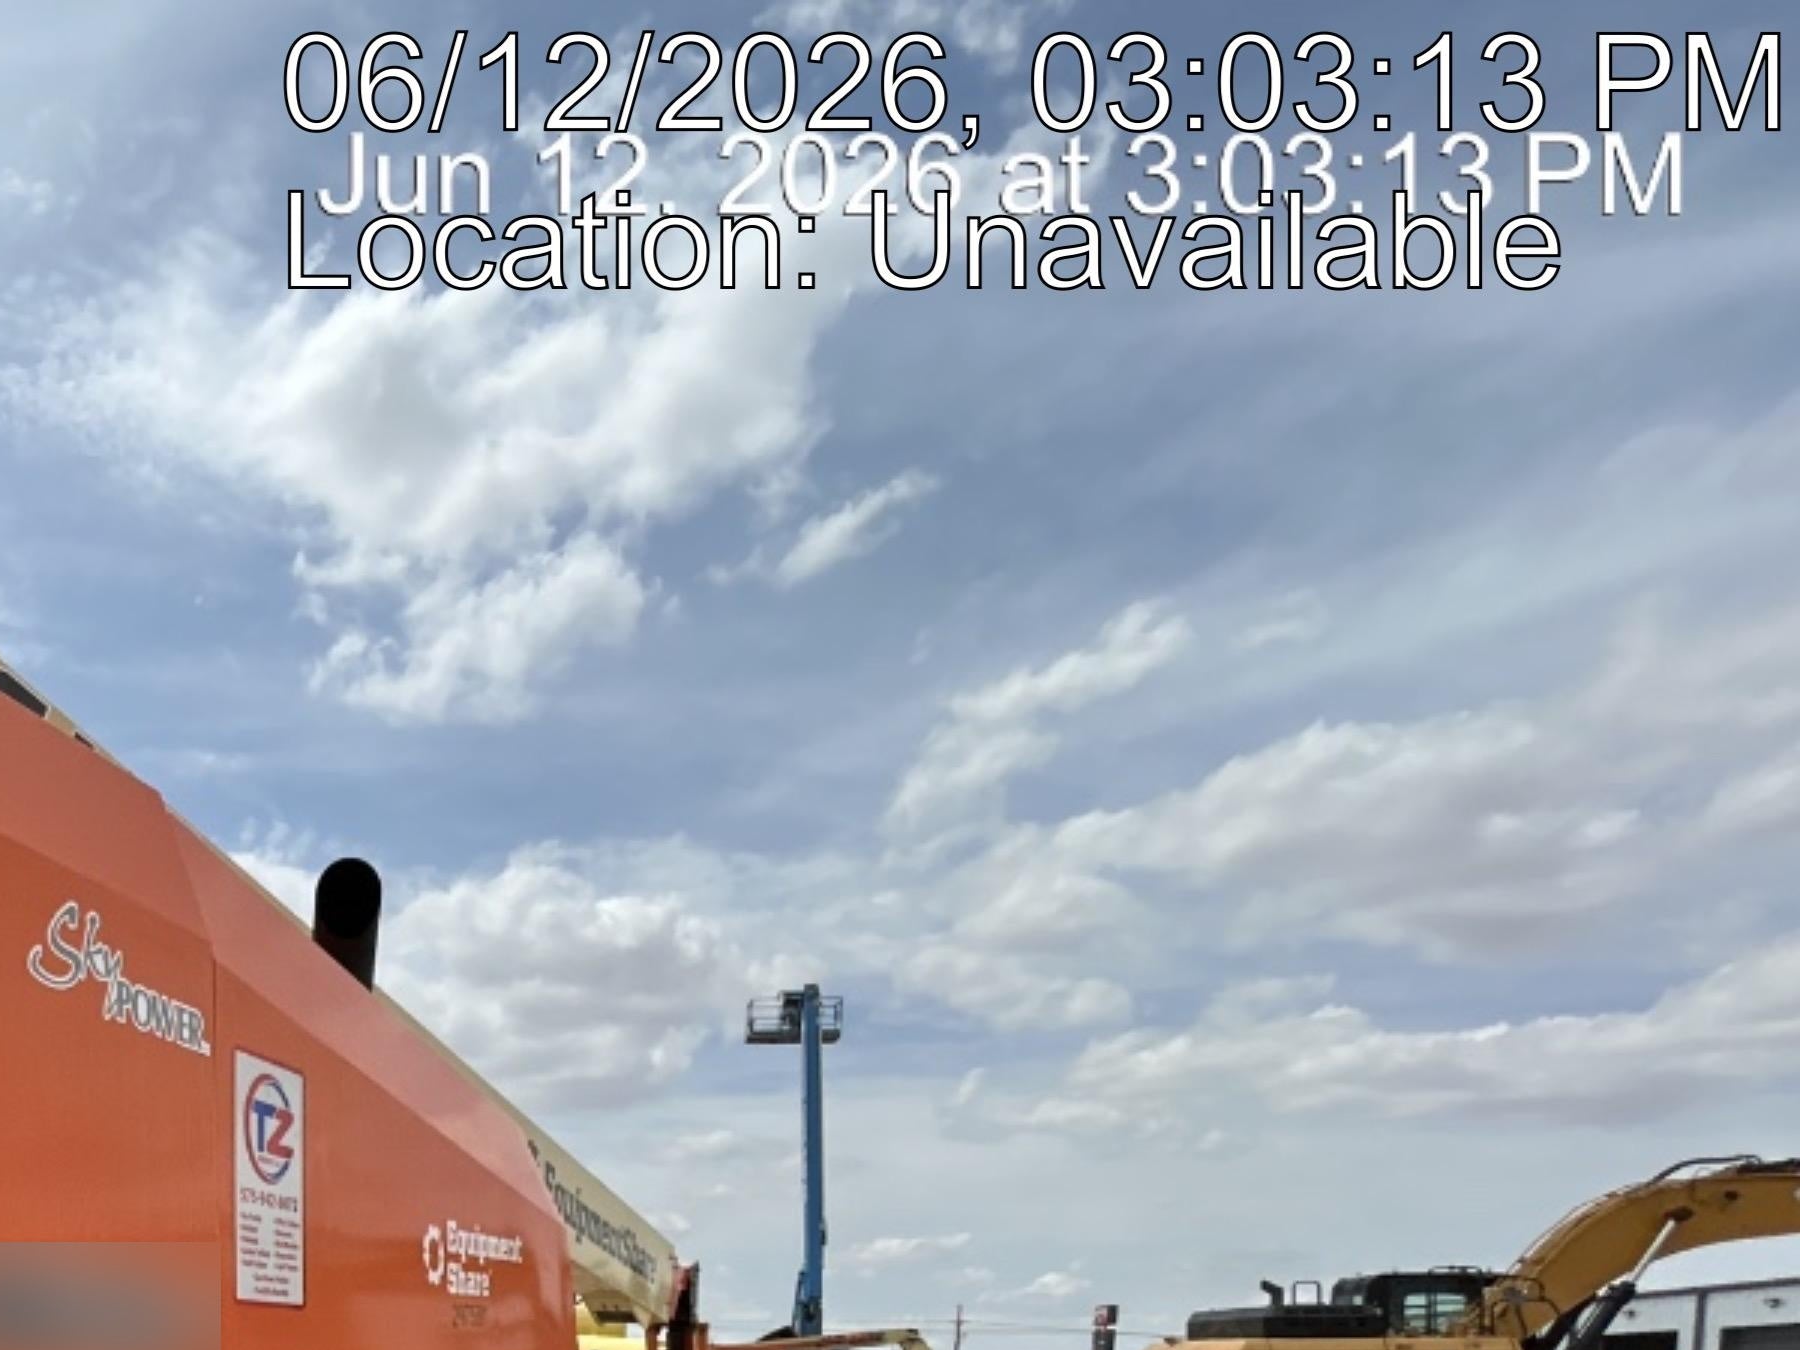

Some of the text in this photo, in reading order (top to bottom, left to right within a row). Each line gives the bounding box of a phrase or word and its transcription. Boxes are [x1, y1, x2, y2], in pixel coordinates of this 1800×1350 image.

[27, 900, 123, 1021] Sky
[111, 976, 205, 1051] POWER
[446, 1261, 490, 1297] Share
